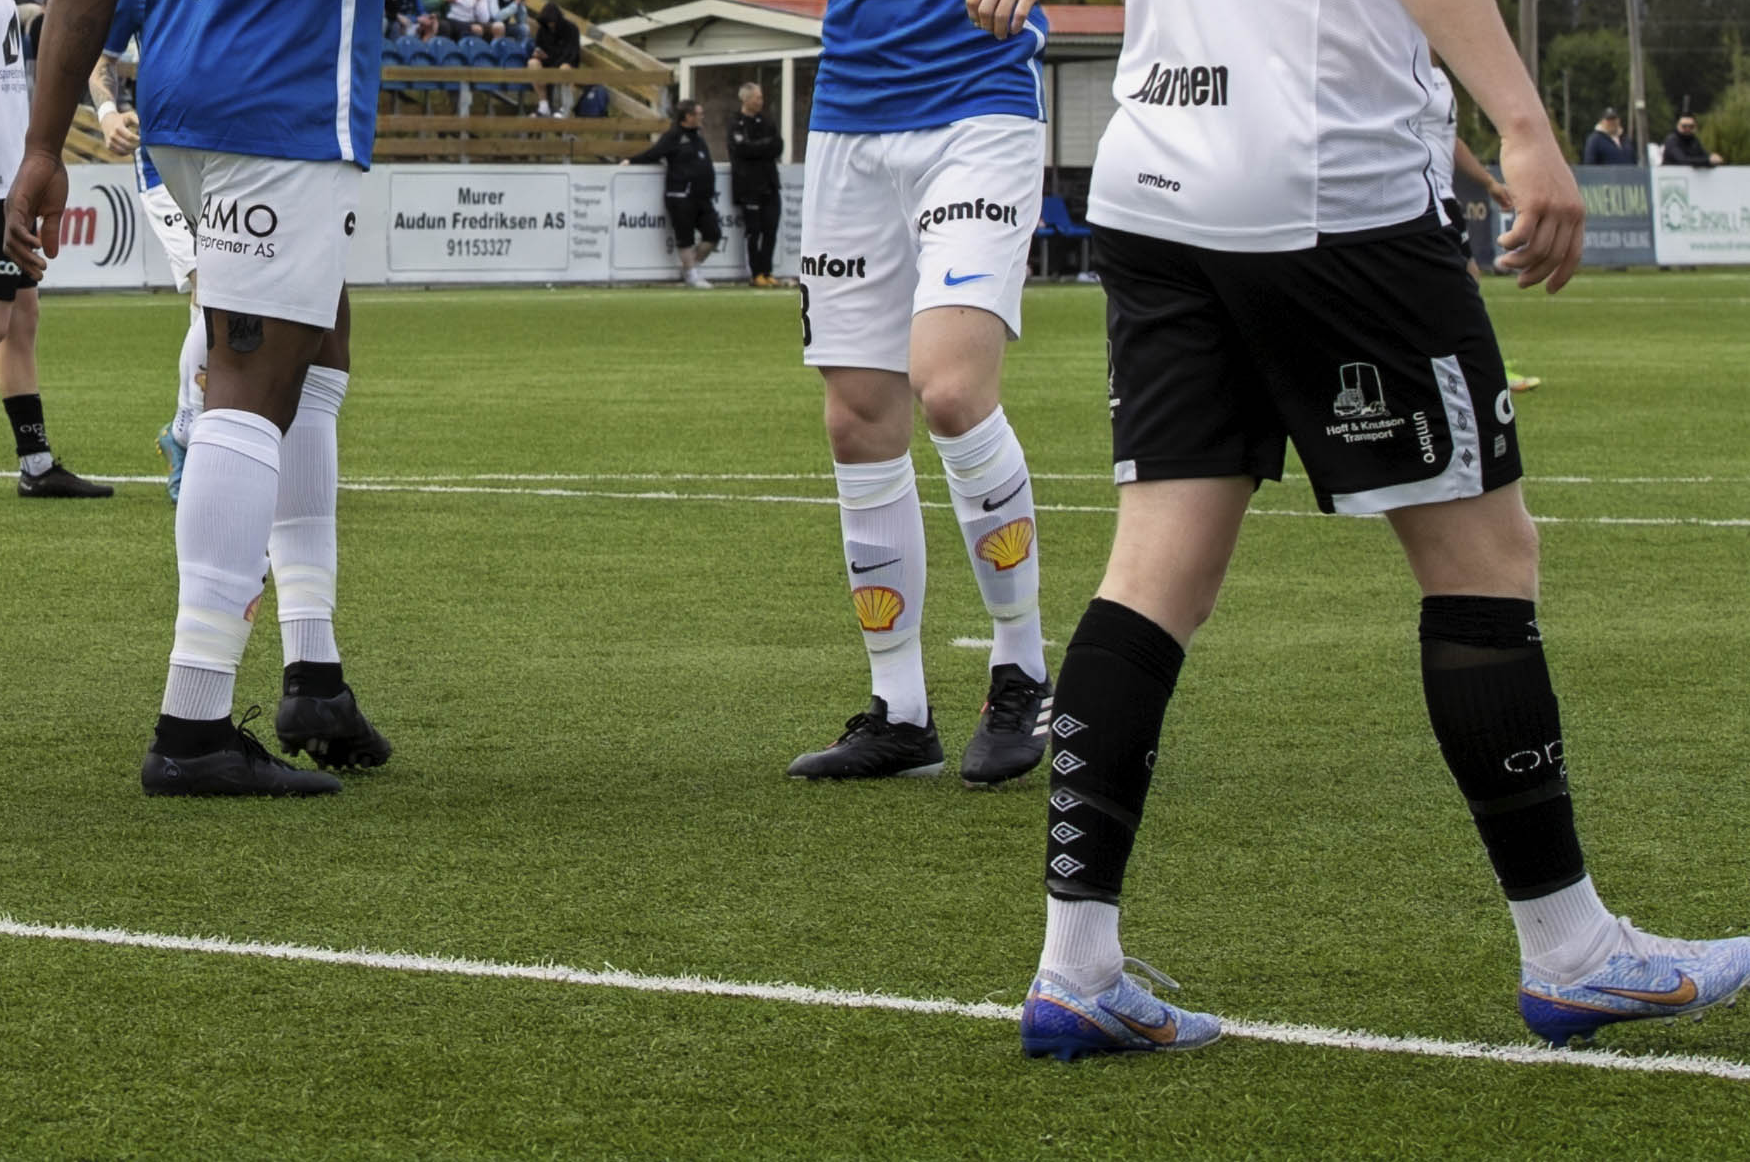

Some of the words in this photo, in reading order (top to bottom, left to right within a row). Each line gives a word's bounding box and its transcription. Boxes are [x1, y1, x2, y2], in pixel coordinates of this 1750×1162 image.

[1137, 171, 1181, 192] umbro
[457, 187, 505, 205] Murer
[394, 211, 447, 230] Audun
[451, 211, 538, 230] Fredriksen
[543, 211, 566, 230] AS
[617, 211, 667, 229] Audun
[918, 197, 1018, 231] comfort
[254, 242, 275, 258] AS
[446, 238, 512, 257] 91153327
[1342, 429, 1394, 444] Transport
[1412, 410, 1436, 464] umbro
